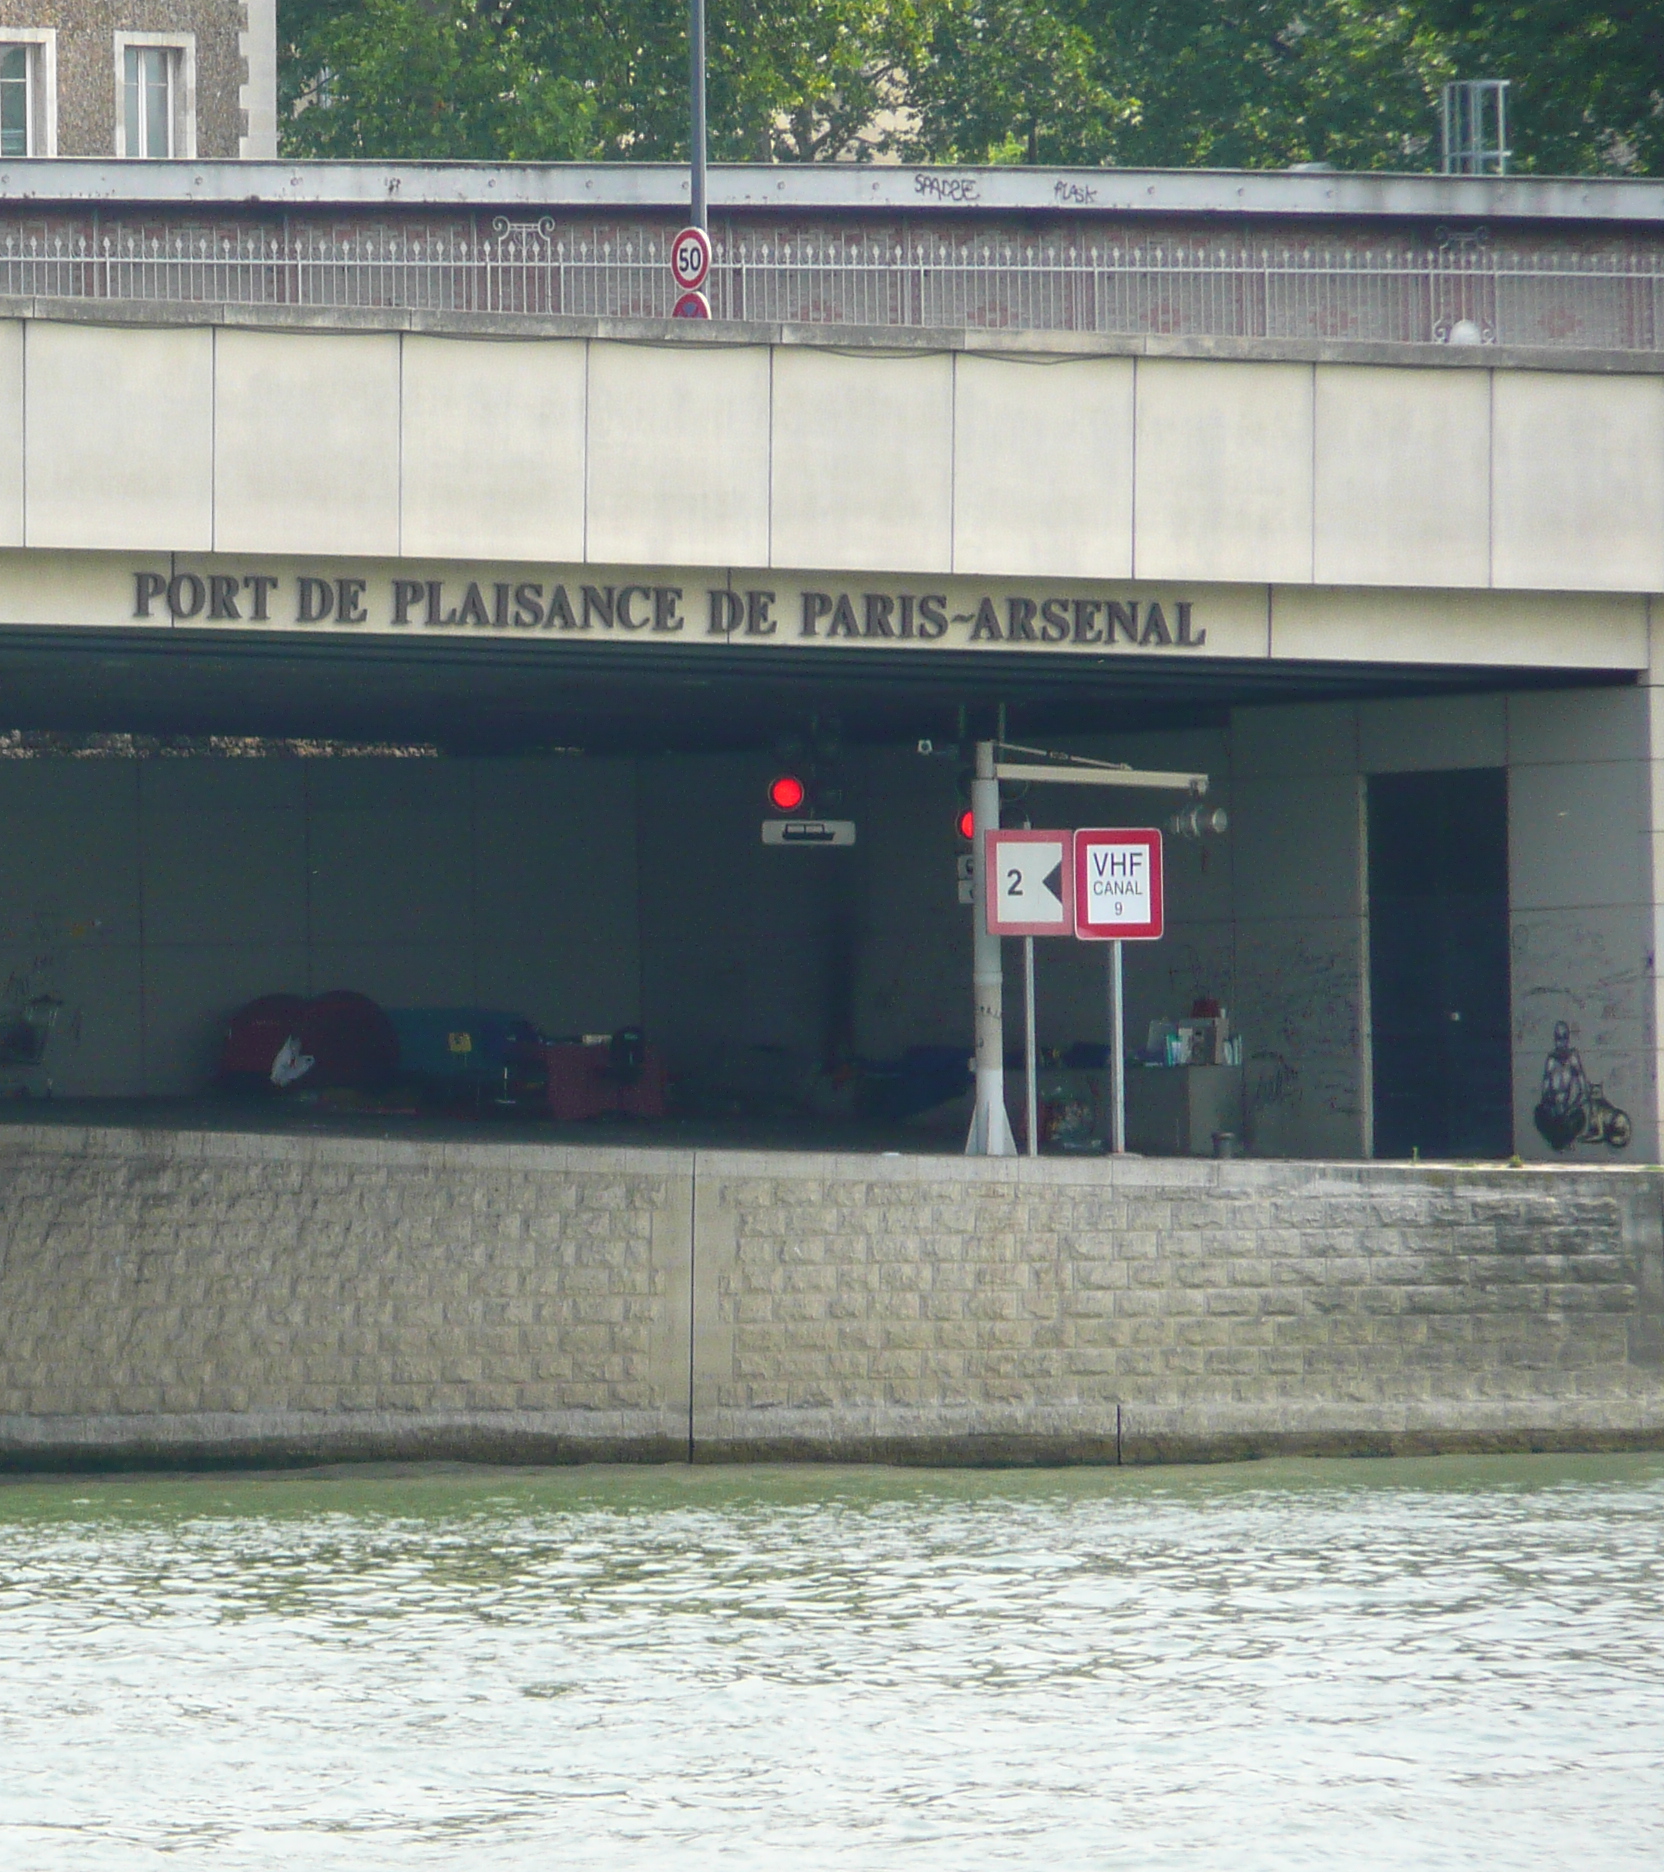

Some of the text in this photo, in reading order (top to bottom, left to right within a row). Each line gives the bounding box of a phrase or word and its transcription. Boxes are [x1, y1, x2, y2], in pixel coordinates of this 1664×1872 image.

[679, 246, 701, 272] 50
[134, 571, 278, 621] PORT
[296, 576, 368, 624] DE
[392, 579, 684, 632] PLAISANCE
[707, 588, 778, 636] DE
[1093, 852, 1143, 877] VHF
[1007, 868, 1023, 896] 2
[1093, 880, 1143, 896] CANAL
[1114, 901, 1124, 917] 9
